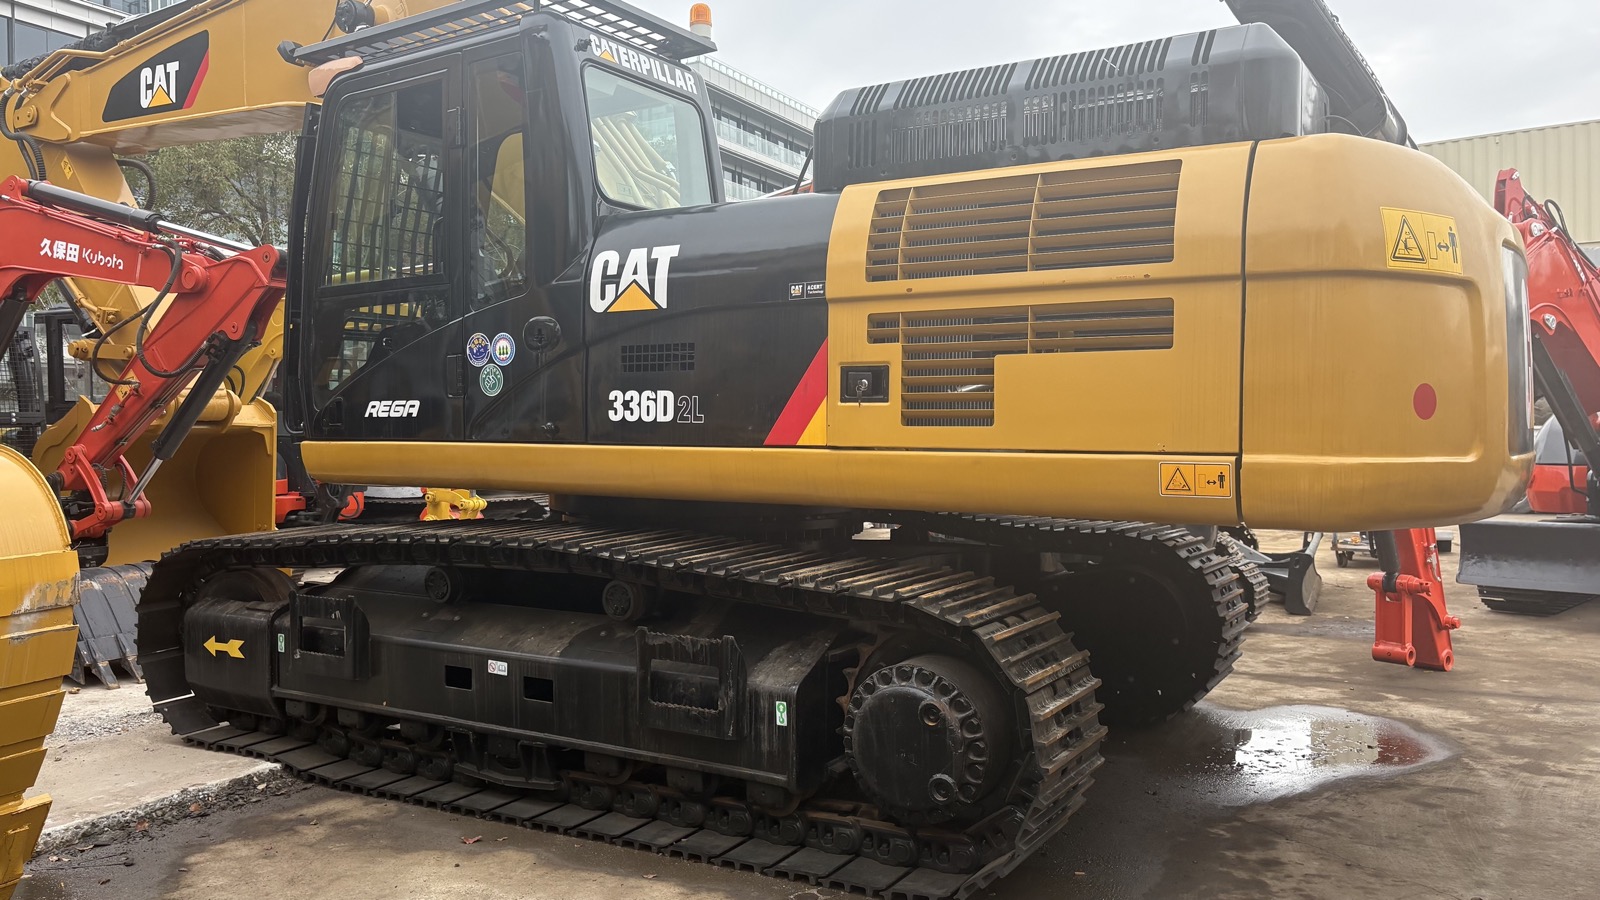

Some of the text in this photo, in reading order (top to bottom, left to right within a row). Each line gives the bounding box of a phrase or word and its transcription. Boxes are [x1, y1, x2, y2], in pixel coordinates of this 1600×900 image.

[140, 60, 180, 109] CAT
[589, 34, 698, 95] CATERPILLAR
[40, 238, 124, 270] 久保田 Kubota
[589, 244, 680, 313] CAT
[790, 285, 802, 296] CAT
[364, 400, 421, 418] REGA
